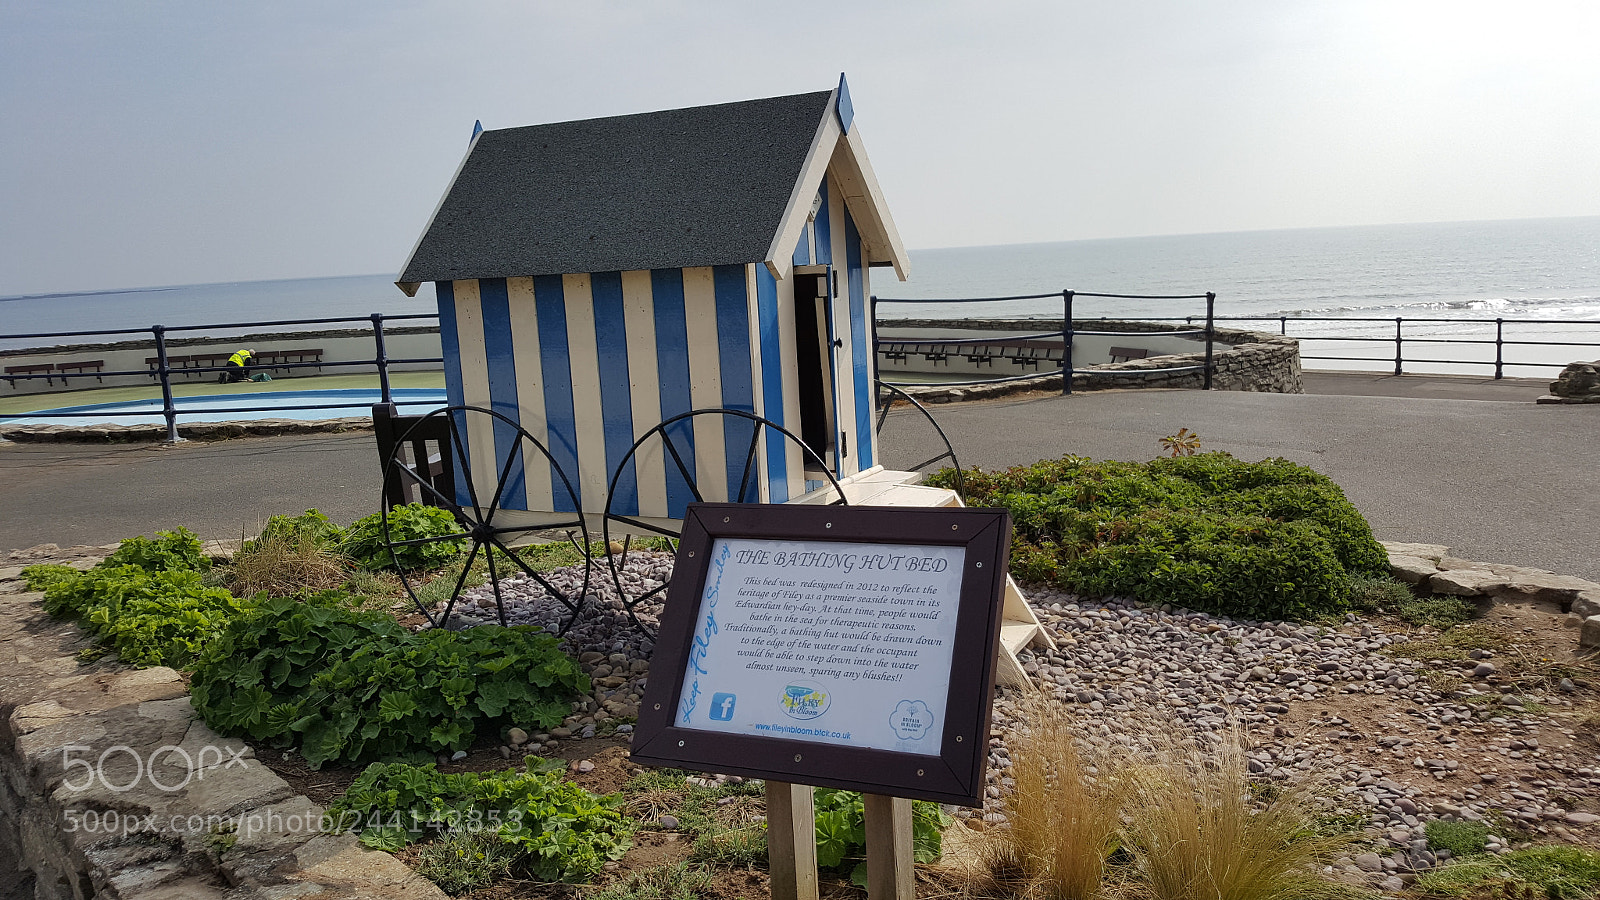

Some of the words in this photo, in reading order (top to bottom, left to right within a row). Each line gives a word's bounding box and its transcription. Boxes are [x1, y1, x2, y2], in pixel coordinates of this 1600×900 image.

[736, 550, 771, 565] THE
[774, 551, 857, 573] BATHING
[859, 554, 906, 571] HUT
[905, 556, 948, 573] BED
[707, 542, 732, 608] Smiley
[744, 577, 760, 585] This
[763, 578, 778, 586] bed
[800, 581, 846, 591] redesigned
[846, 582, 854, 590] in
[856, 582, 878, 591] 2012
[880, 584, 890, 592] to
[892, 584, 920, 595] reflect
[923, 586, 937, 595] the
[737, 588, 769, 600] heritage
[771, 590, 782, 601] of
[782, 591, 803, 601] Filey
[824, 593, 856, 603] premier
[857, 594, 889, 604] seaside
[891, 598, 914, 606] town
[917, 598, 926, 606] in
[928, 598, 940, 607] its
[735, 600, 781, 610] Edwardian
[783, 601, 817, 614] hey-day.
[818, 605, 831, 613] At
[834, 605, 852, 614] that
[855, 607, 875, 617] time,
[878, 609, 906, 620] people
[910, 610, 941, 620] would
[750, 612, 772, 622] bathe
[774, 614, 782, 622] in
[785, 614, 798, 623] the
[812, 616, 828, 627] for
[830, 617, 879, 628] therapeutic
[881, 622, 916, 632] reasons.
[691, 611, 719, 675] Filey
[724, 623, 778, 636] Traditionally,
[789, 627, 821, 639] bathing
[823, 629, 839, 638] hut
[842, 631, 871, 641] would
[872, 632, 881, 641] be
[883, 633, 913, 643] drawn
[915, 635, 942, 646] down
[751, 637, 764, 646] the
[766, 638, 784, 648] edge
[786, 639, 798, 649] of
[799, 640, 812, 648] the
[814, 643, 840, 651] water
[841, 644, 860, 653] and
[861, 645, 874, 653] the
[876, 648, 918, 658] occupant
[737, 650, 763, 658] would
[765, 651, 774, 659] be
[776, 651, 793, 660] able
[795, 653, 804, 661] to
[806, 654, 825, 664] step
[826, 654, 850, 664] down
[854, 657, 872, 666] into
[874, 658, 888, 667] the
[891, 661, 919, 670] water
[745, 661, 773, 670] almost
[776, 665, 806, 674] unseen,
[809, 667, 841, 679] sparing
[843, 671, 860, 681] any
[863, 670, 903, 682] blushes!!
[682, 677, 701, 724] Keep
